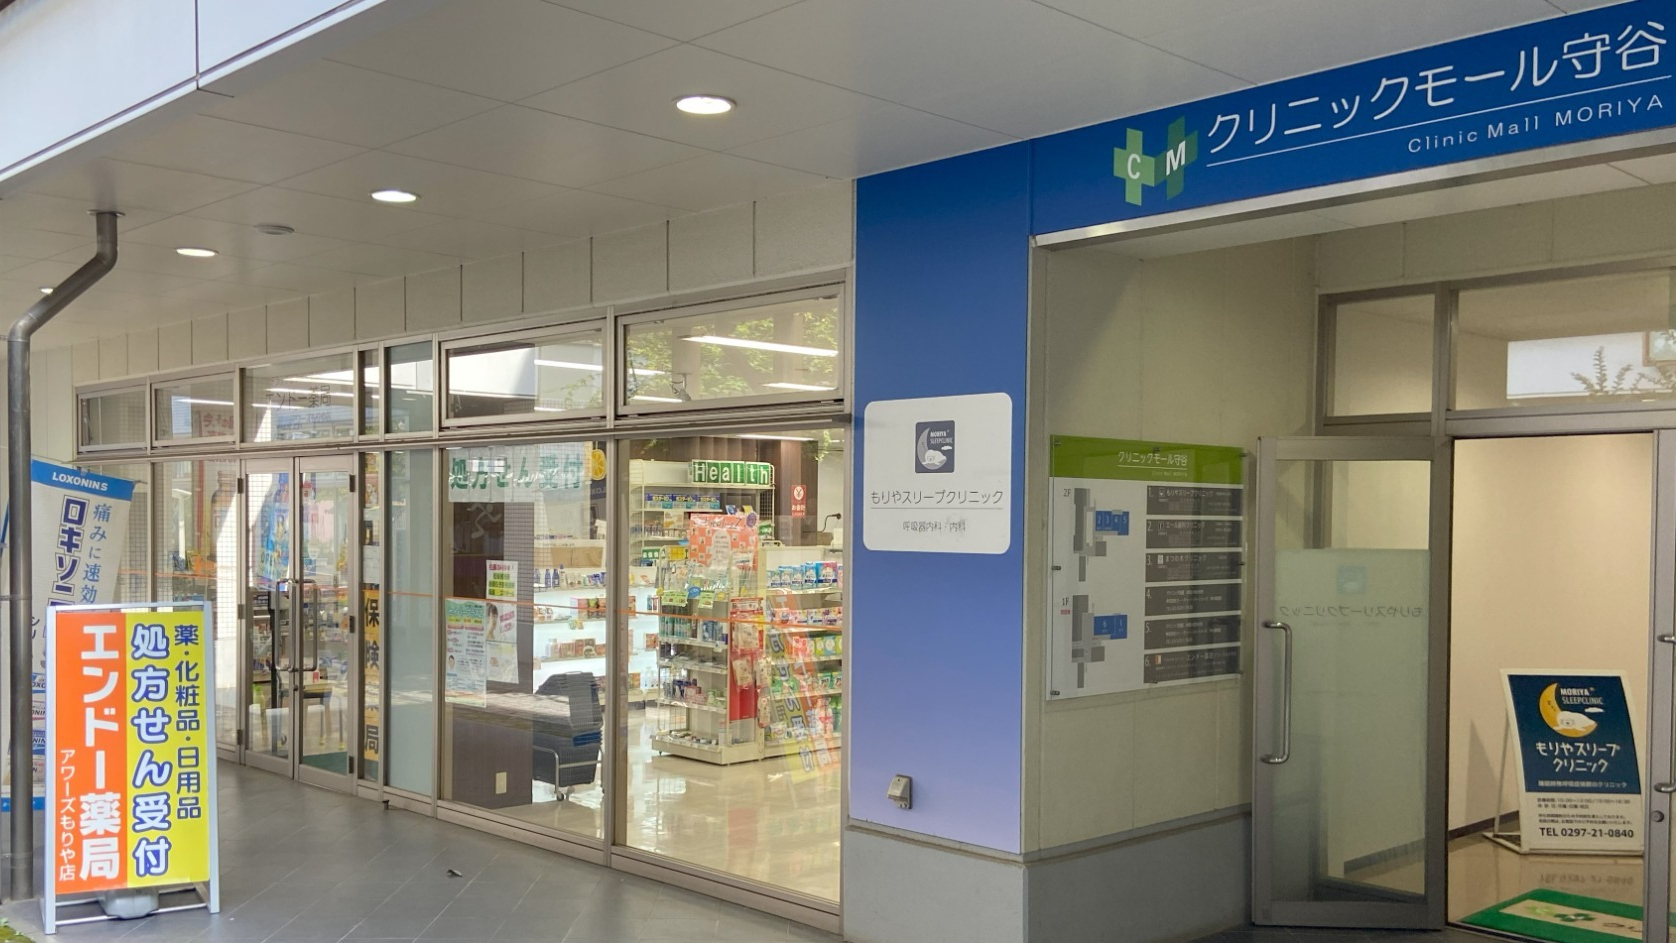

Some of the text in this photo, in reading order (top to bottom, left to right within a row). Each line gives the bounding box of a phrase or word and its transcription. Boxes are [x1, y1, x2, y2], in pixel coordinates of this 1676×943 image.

[1209, 20, 1667, 153] クリニックモール守谷
[1407, 94, 1664, 154] Clinic Mall MORIYA
[1127, 141, 1187, 180] C M
[1117, 451, 1188, 467] クリニックモール守谷
[52, 471, 109, 492] LOXONINS
[694, 462, 769, 484] Health
[870, 489, 1004, 505] もりやスリープクリニック
[1560, 687, 1590, 696] MORIYA
[173, 624, 202, 820] 薬・化粧品・日用品
[79, 624, 122, 881] エンドー薬局
[130, 623, 173, 878] 処方せん受付
[1535, 741, 1621, 757] もりやスリープ
[1552, 757, 1609, 774] クリニック
[59, 749, 77, 882] アワーズもりや店
[1539, 827, 1634, 839] TEL 0297-21-0840
